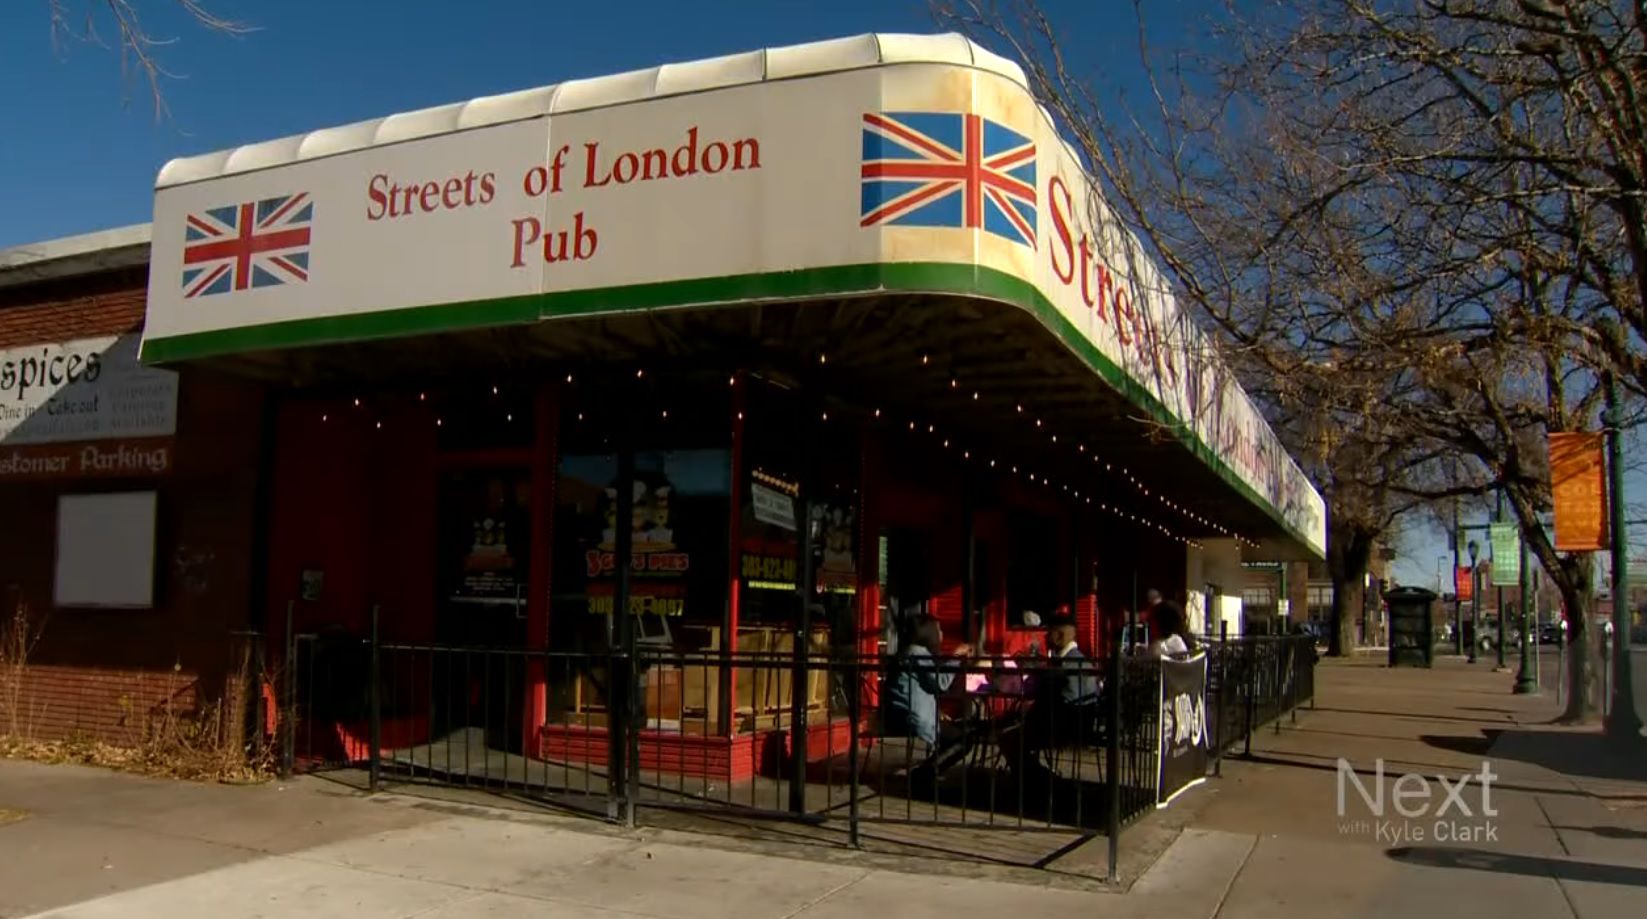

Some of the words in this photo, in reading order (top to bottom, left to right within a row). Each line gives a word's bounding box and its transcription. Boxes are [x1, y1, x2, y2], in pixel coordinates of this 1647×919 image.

[367, 169, 495, 221] Streets
[524, 145, 569, 197] of
[583, 126, 761, 189] London
[510, 212, 598, 269] Pub
[0, 347, 101, 400] spices
[80, 445, 168, 471] Parking
